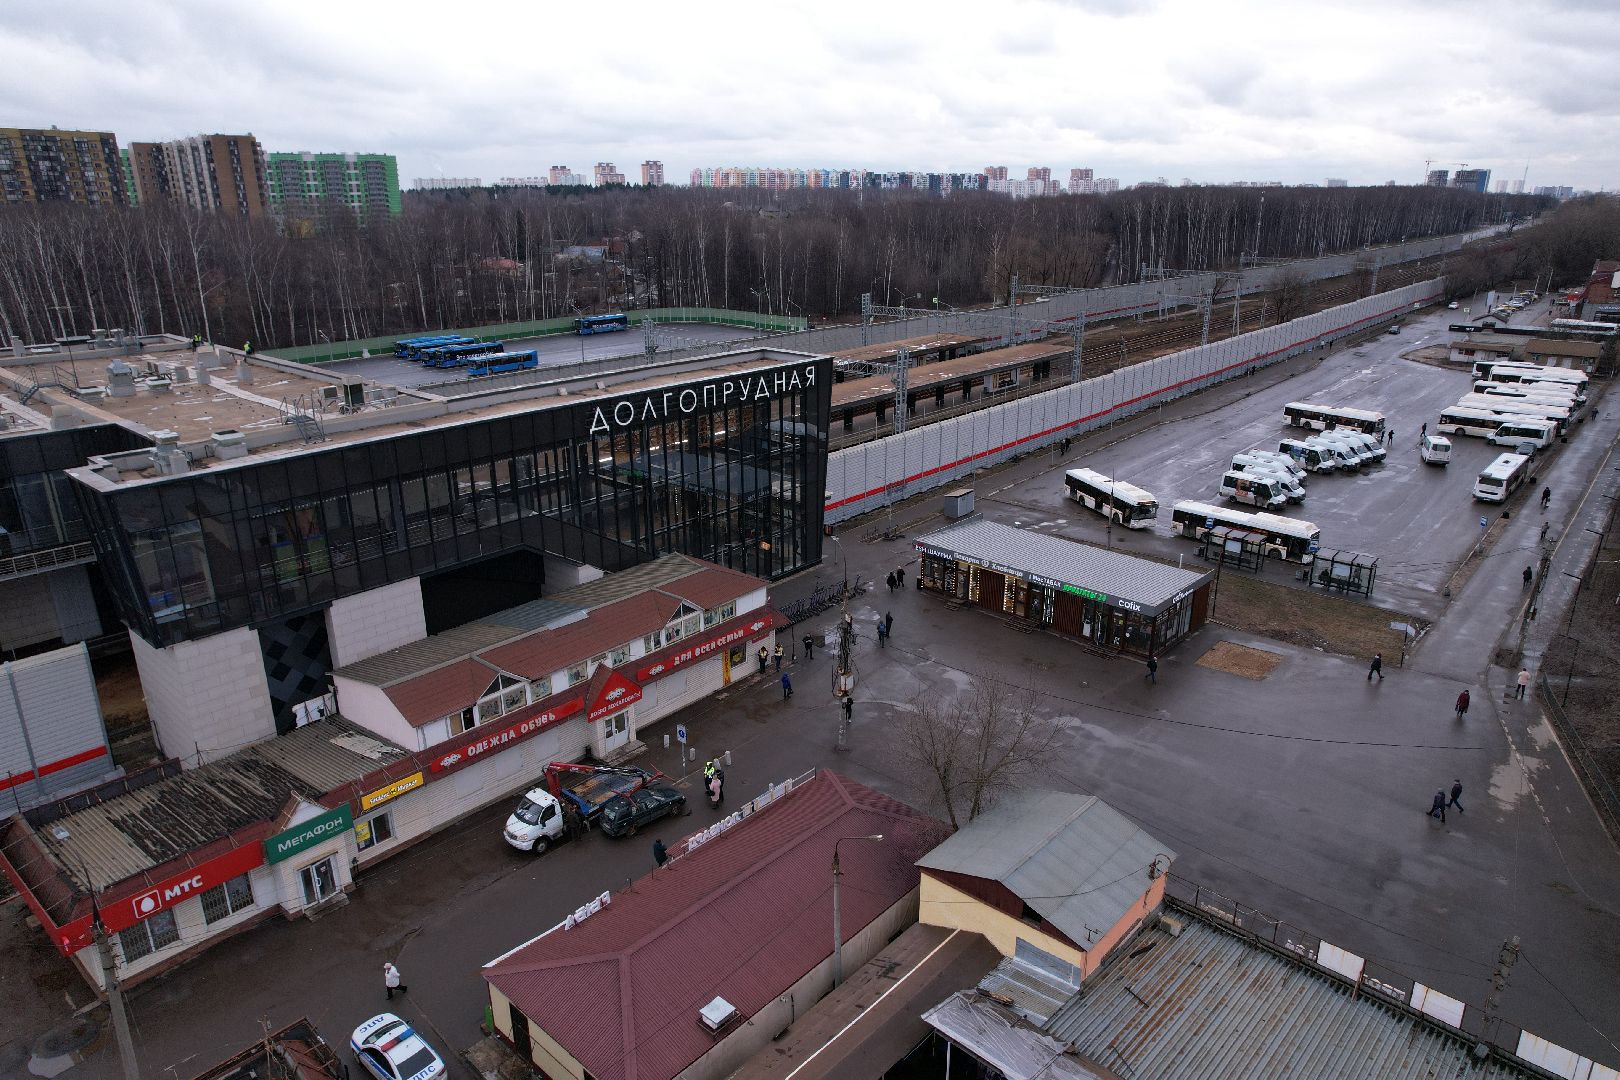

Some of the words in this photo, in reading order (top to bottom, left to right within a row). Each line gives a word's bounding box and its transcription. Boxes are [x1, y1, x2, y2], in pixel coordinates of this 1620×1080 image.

[590, 366, 815, 435] ДОЛГОПРУДНАЯ
[1118, 599, 1141, 612] cofix
[674, 651, 692, 666] ДЛЯ
[694, 641, 716, 657] ВСЕЙ
[717, 629, 744, 647] СЕМЬИ
[467, 729, 516, 757] ОДЕЖДА
[520, 712, 556, 734] ОБУВЬ
[164, 874, 204, 901] МТС
[359, 1015, 385, 1034] ДПС
[412, 1065, 436, 1080] ДПС
